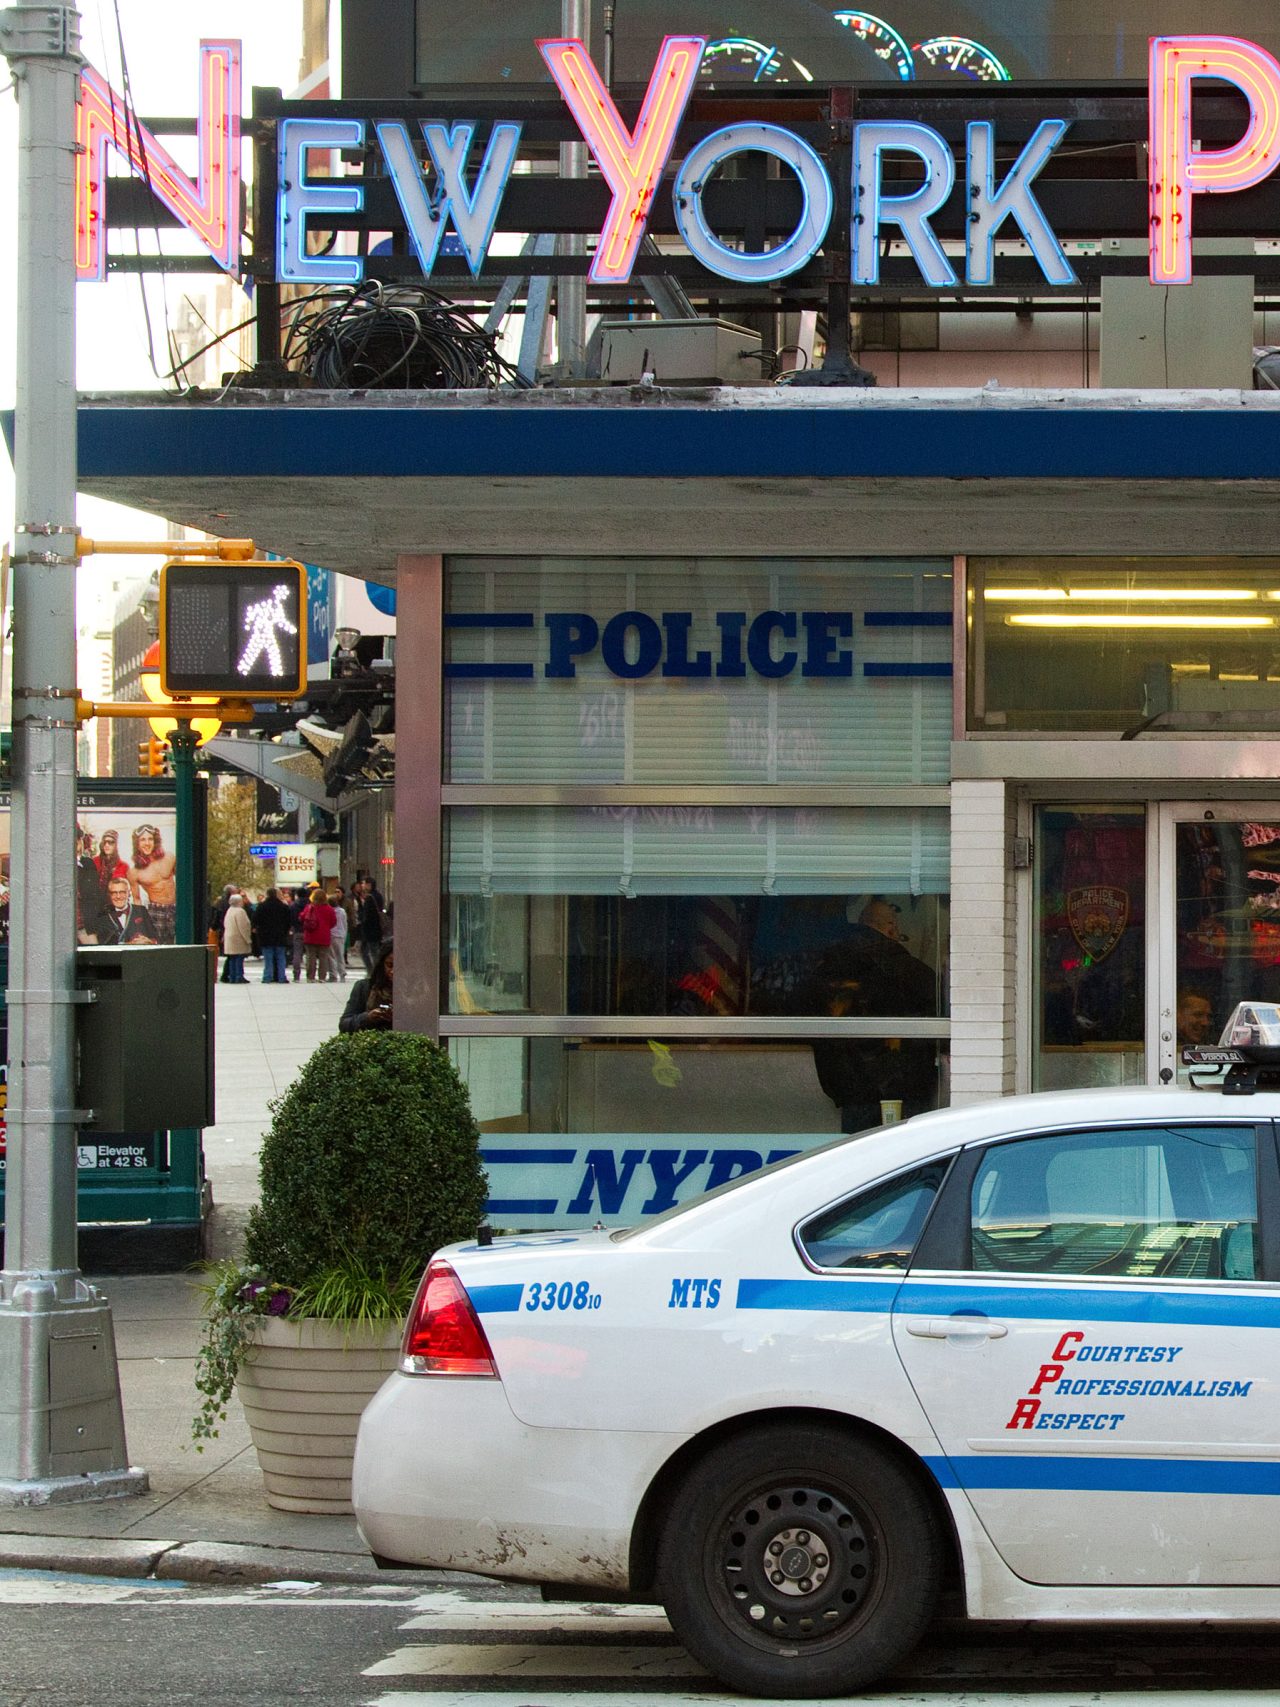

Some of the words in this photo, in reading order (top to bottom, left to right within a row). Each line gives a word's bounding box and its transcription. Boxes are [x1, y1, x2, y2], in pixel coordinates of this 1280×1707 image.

[75, 39, 524, 284] NEW
[535, 35, 1080, 286] YORK
[544, 610, 854, 679] POLICE
[279, 856, 315, 865] Office
[1072, 896, 1124, 912] DEPARTMENT
[1082, 889, 1114, 899] POLICE
[98, 1146, 145, 1156] Elevator
[98, 1158, 110, 1167] at
[114, 1157, 131, 1167] 42
[134, 1157, 148, 1167] St
[566, 1150, 802, 1214] NYP
[668, 1278, 722, 1310] MTS
[1051, 1331, 1183, 1363] COURTESY
[1028, 1364, 1253, 1397] PROFESSIONALISM
[1005, 1398, 1126, 1431] RESPECT
